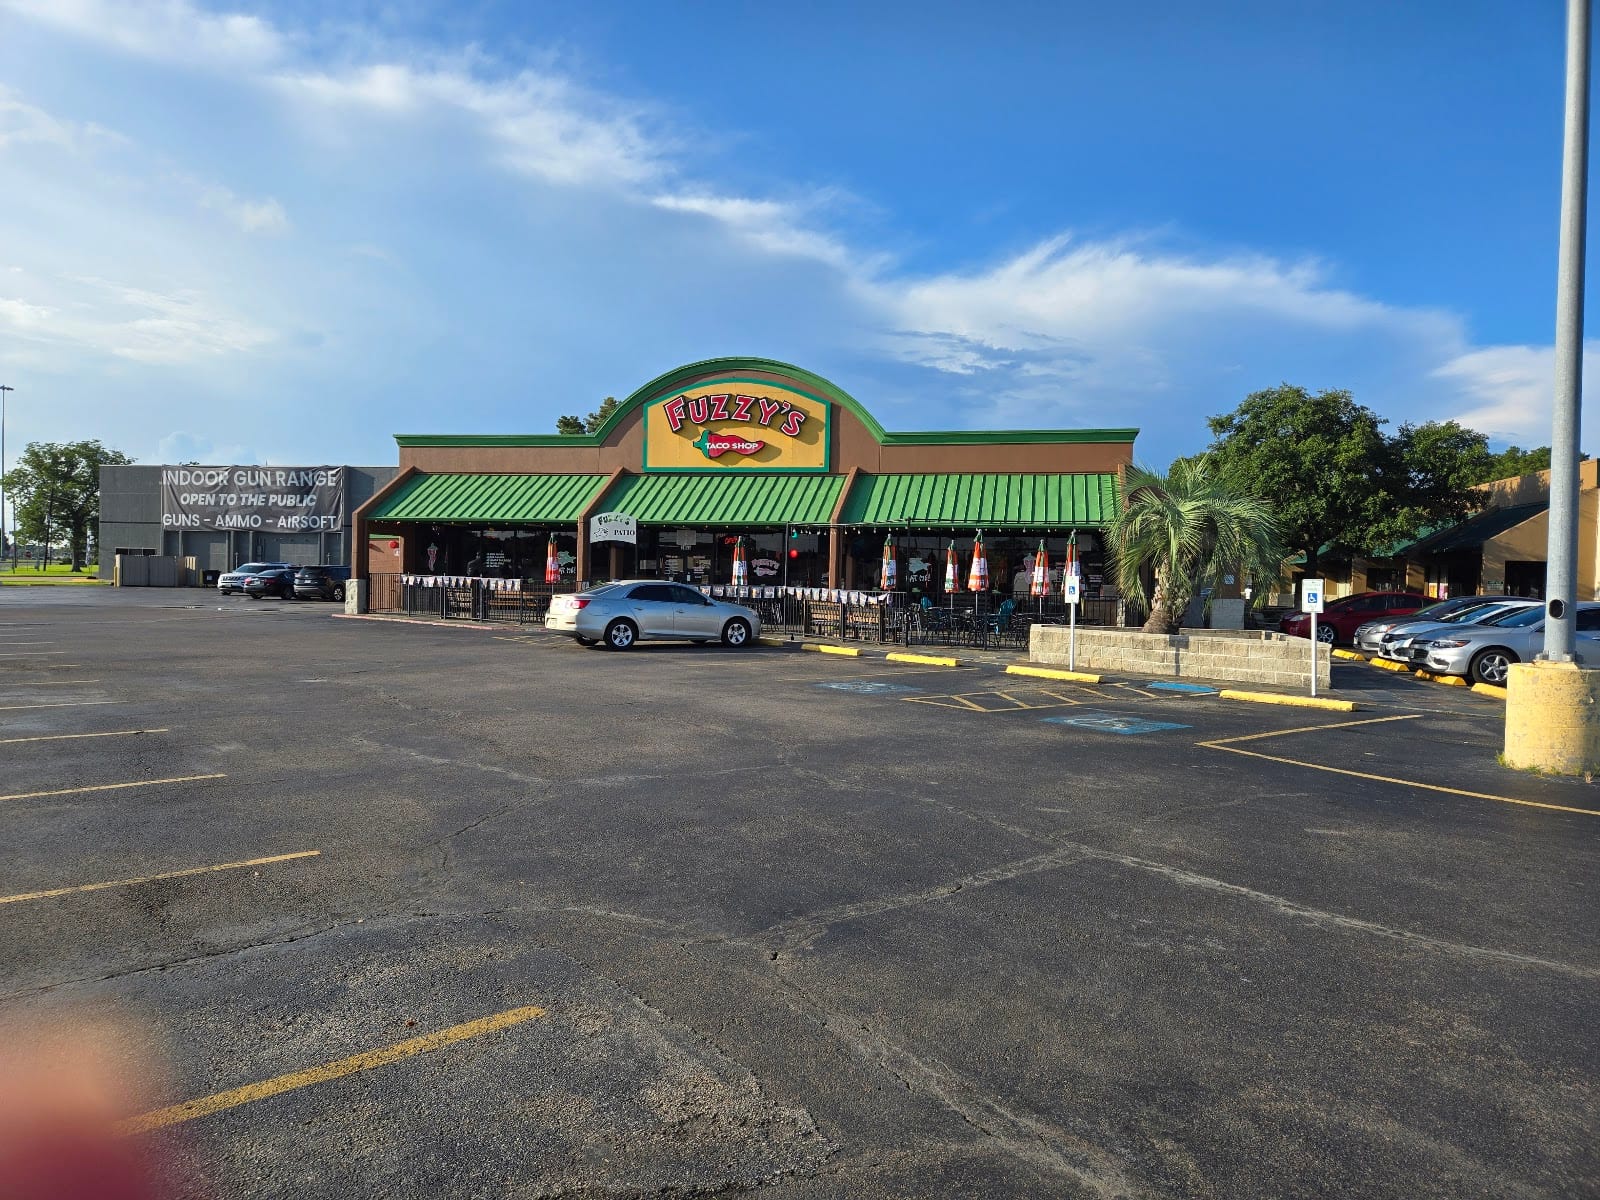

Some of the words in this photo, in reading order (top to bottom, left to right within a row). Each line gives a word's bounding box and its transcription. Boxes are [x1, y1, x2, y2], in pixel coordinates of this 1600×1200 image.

[663, 394, 806, 436] FUZZY'S
[162, 470, 229, 486] INDOOR
[234, 471, 271, 486] GUN
[276, 470, 337, 487] RANGE
[180, 493, 215, 506] OPEN
[219, 493, 237, 506] TO
[240, 493, 267, 506] THE
[268, 494, 317, 507] PUBLIC
[162, 513, 200, 526] GUNS
[214, 514, 262, 528] AMMO
[277, 515, 337, 529] AIRSOFT
